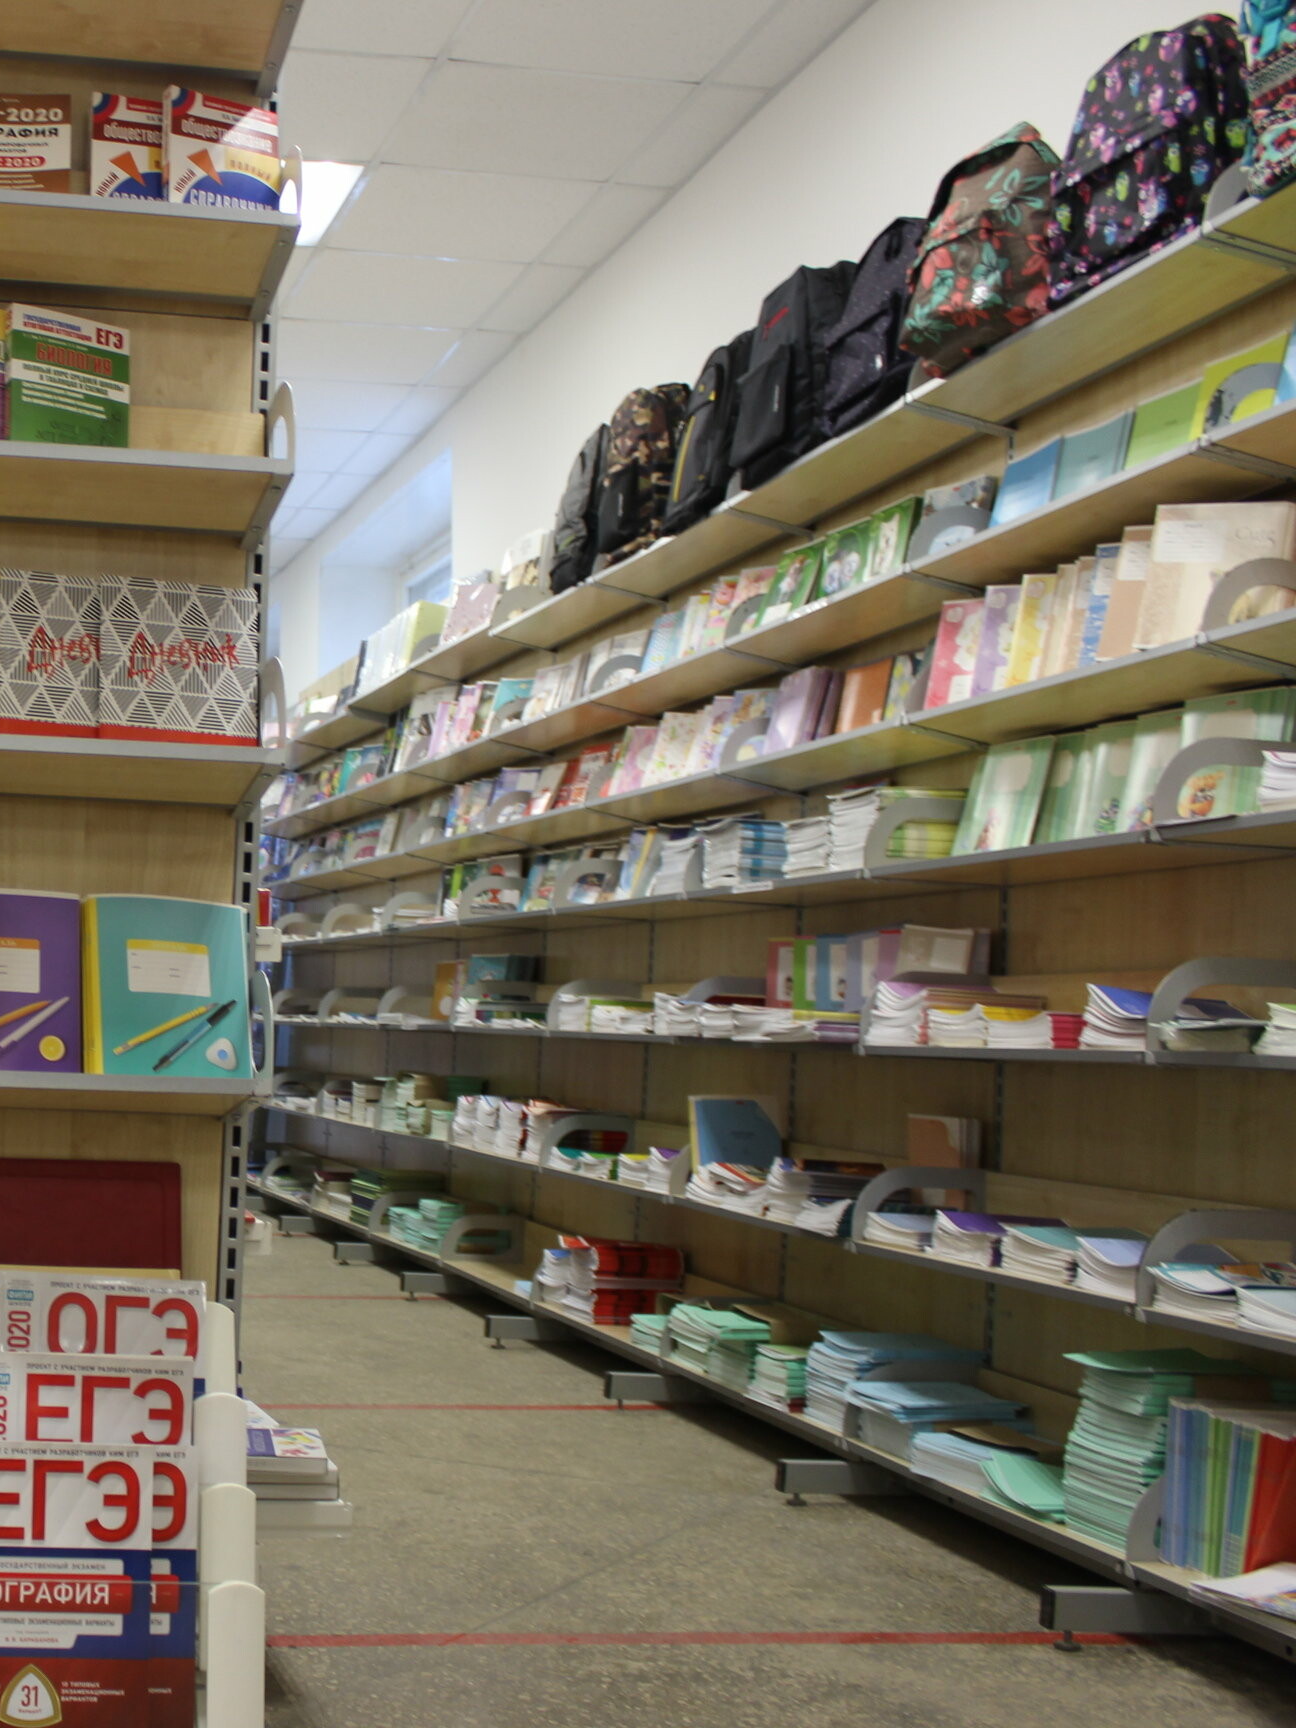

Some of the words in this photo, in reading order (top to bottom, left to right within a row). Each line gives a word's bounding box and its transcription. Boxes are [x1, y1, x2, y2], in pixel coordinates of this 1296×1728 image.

[4, 158, 41, 168] 2020
[95, 327, 124, 350] ЕГЭ
[7, 1309, 32, 1353] 020
[47, 1292, 199, 1360] ОГЭ
[25, 1373, 185, 1445] ЕГЭ
[21, 1685, 39, 1707] 31
